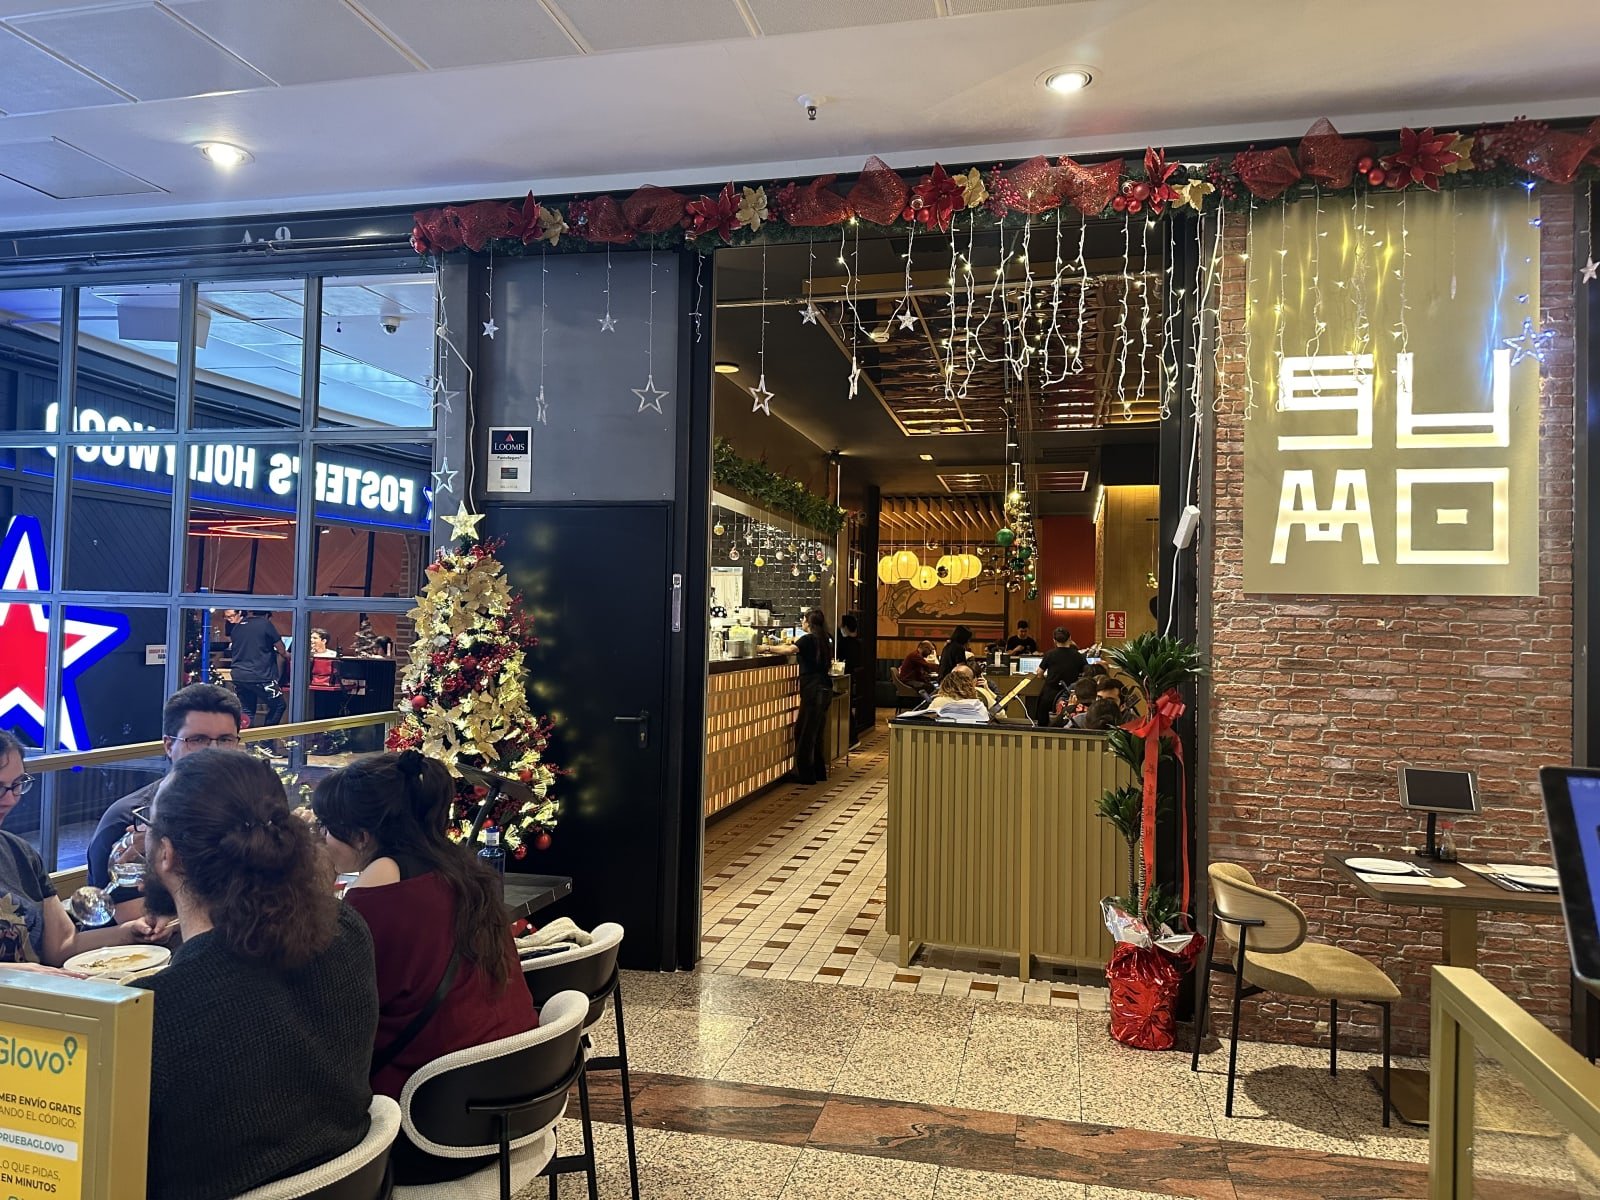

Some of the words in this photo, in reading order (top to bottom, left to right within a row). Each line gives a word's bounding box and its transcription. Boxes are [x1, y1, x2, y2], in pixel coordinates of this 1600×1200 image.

[494, 442, 525, 451] LOOMIS
[19, 1095, 47, 1109] ENVÍO
[49, 1101, 82, 1116] GRATIS
[26, 1110, 37, 1121] EL
[38, 1112, 77, 1128] CÓDIGO:
[11, 1161, 30, 1174] QUE
[32, 1166, 61, 1181] PIDAS,
[1, 1173, 13, 1184] EN
[16, 1176, 57, 1193] MINUTOS
